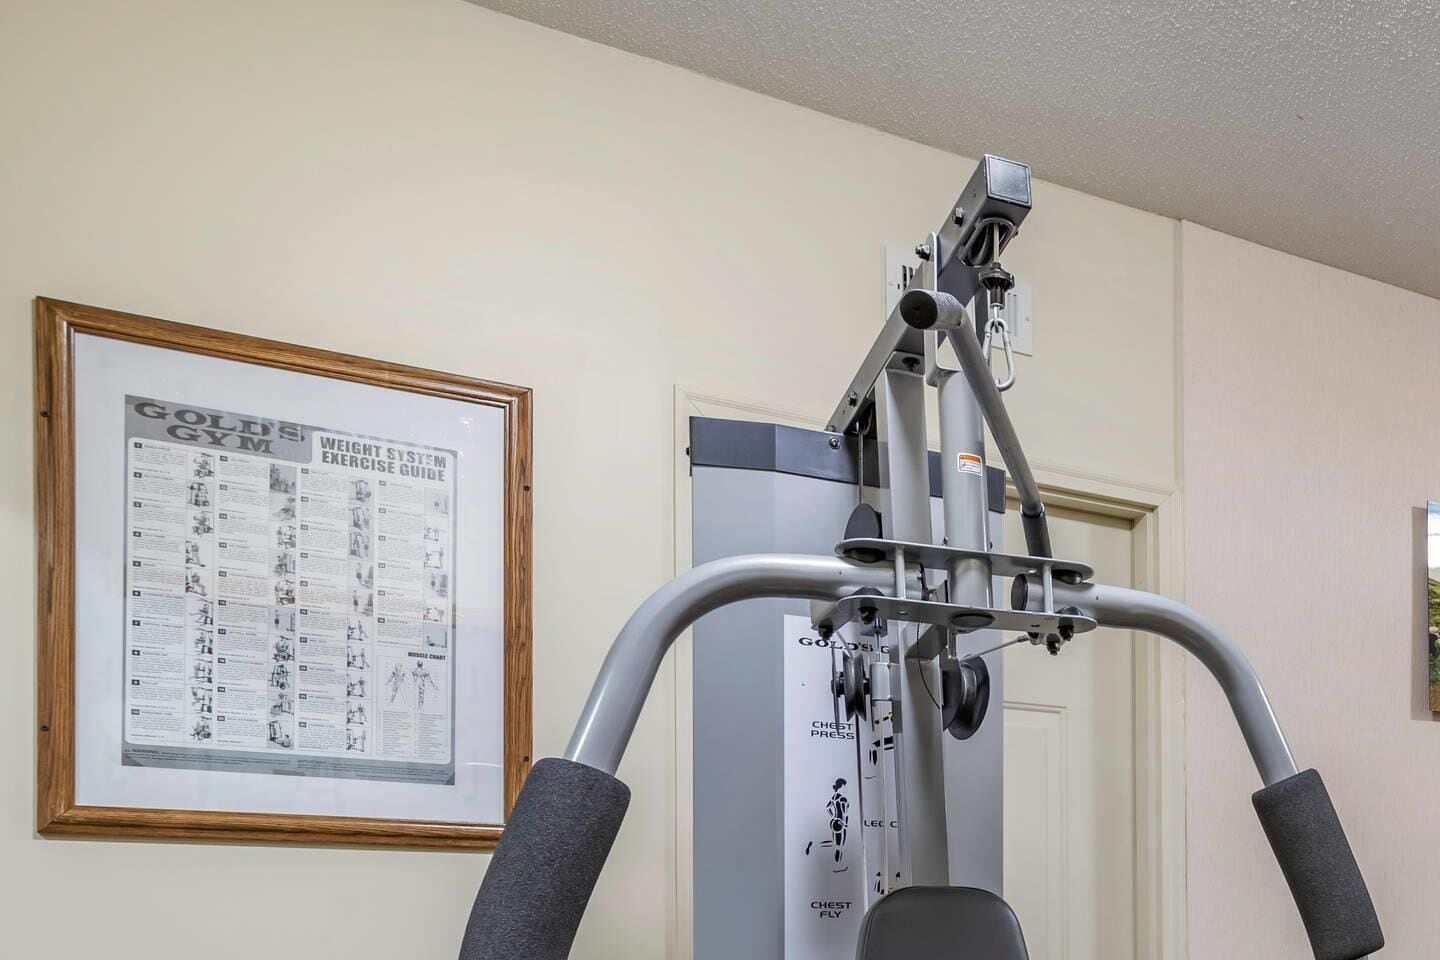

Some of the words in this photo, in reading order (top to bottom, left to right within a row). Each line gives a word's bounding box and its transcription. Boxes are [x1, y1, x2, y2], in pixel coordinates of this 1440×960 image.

[134, 402, 305, 442] GOLD'S
[166, 424, 273, 454] GYM
[319, 436, 382, 458] WEIGHT
[386, 447, 447, 468] SYSTEM
[321, 450, 395, 474] EXERCISE
[399, 463, 446, 481] GUIDE
[811, 730, 855, 740] PRESS
[812, 720, 853, 731] CHEST
[811, 901, 853, 910] CHEST
[820, 910, 842, 919] FLY
